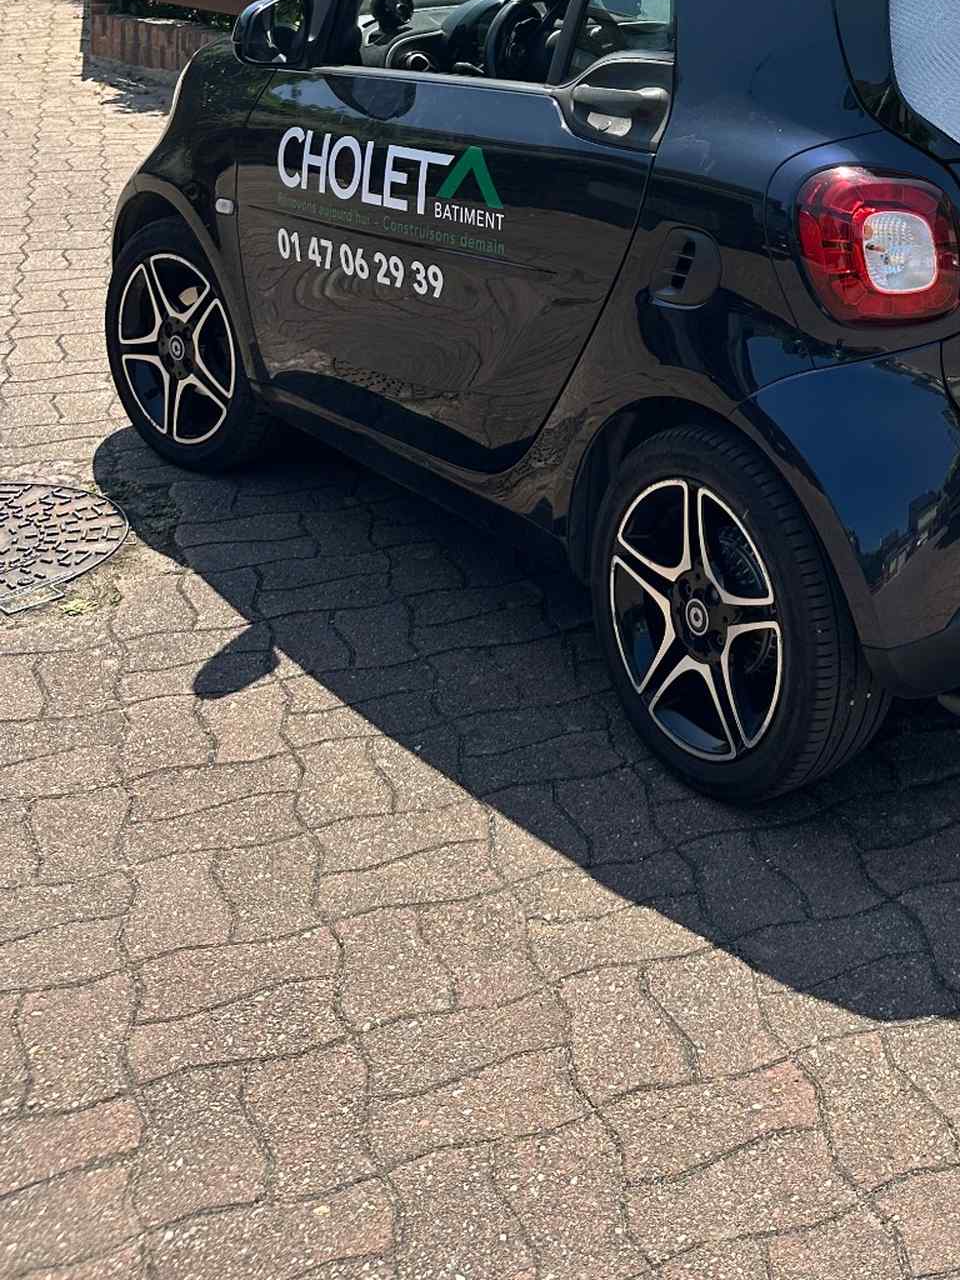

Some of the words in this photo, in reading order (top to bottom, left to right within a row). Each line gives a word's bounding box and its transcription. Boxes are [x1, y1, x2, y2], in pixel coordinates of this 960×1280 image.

[277, 126, 455, 215] CHOLET
[383, 215, 456, 244] Construisons
[459, 232, 505, 257] demain
[434, 201, 505, 232] BATIMENT
[277, 227, 302, 262] 01
[307, 235, 333, 270] 47
[339, 243, 370, 280] 06
[373, 251, 405, 289] 29
[410, 260, 444, 299] 39
